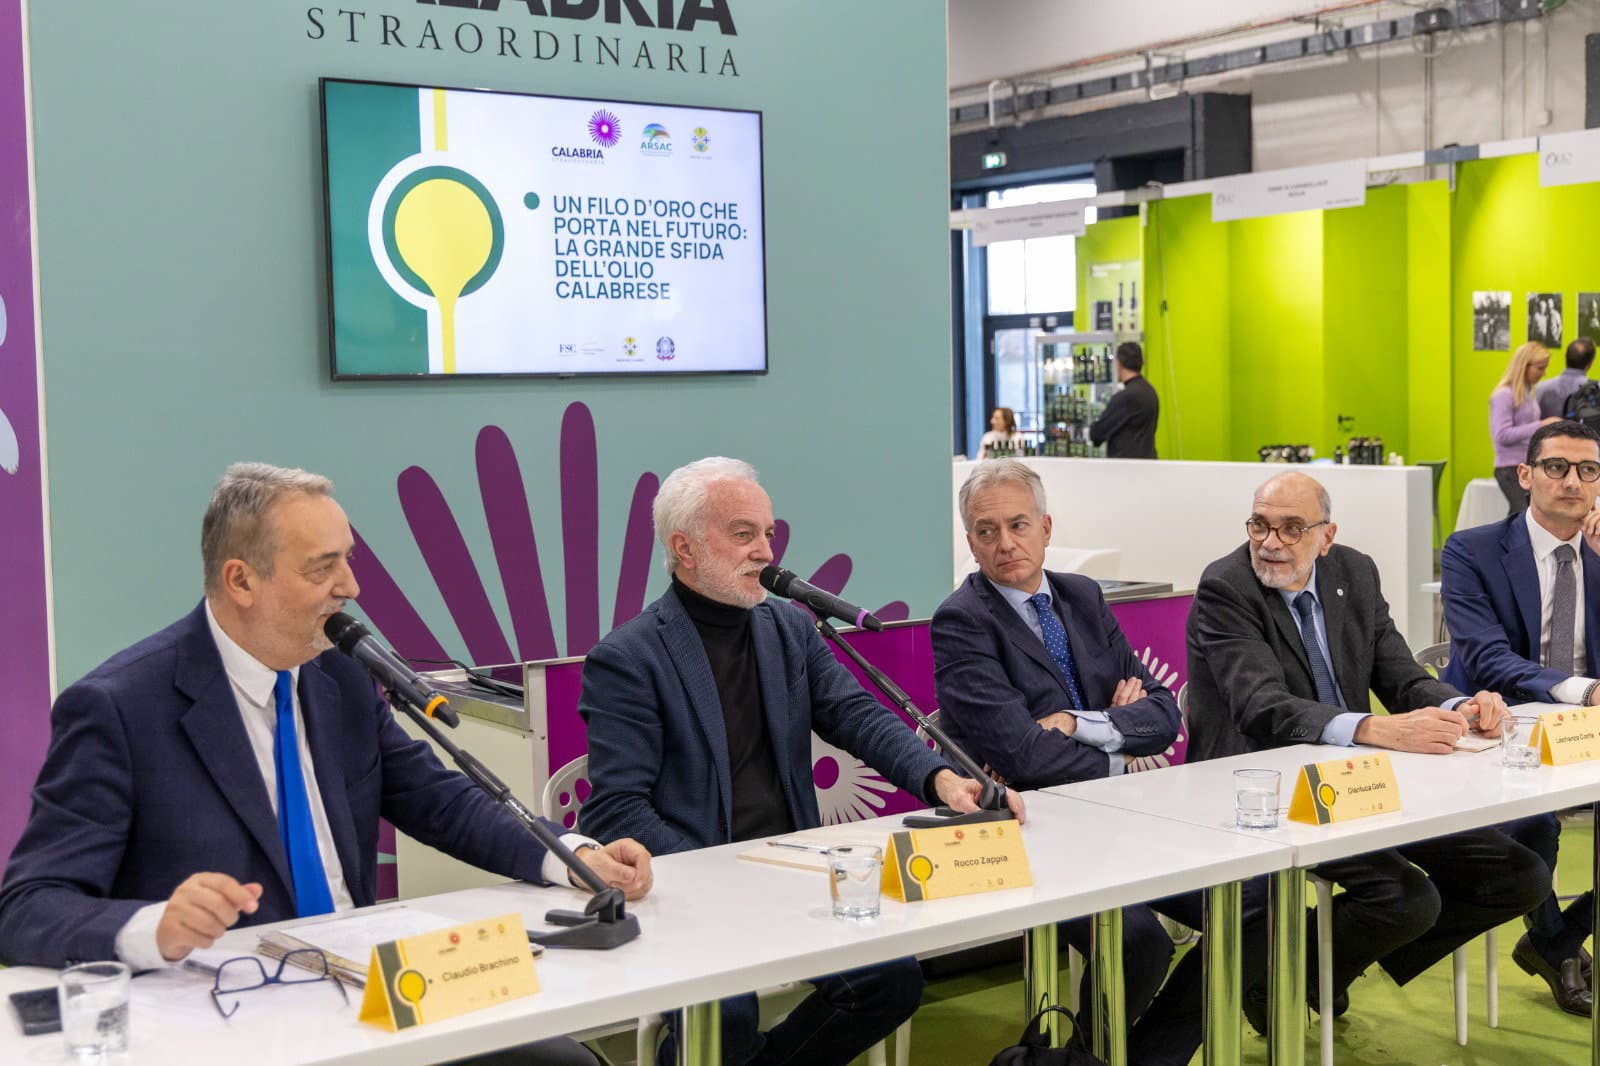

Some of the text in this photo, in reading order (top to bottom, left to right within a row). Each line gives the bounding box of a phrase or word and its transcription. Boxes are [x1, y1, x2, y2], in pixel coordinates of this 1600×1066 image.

[306, 7, 741, 77] STRAORDINARIA
[551, 146, 605, 159] CALABRIA
[639, 141, 673, 152] ARSAC
[553, 195, 582, 214] UN
[587, 196, 629, 216] FILO
[699, 202, 738, 220] CHE
[554, 217, 748, 241] PORTA NEL FUTURO:
[554, 238, 725, 260] LA GRANDE SFIDA
[555, 281, 671, 300] CALABRESE
[954, 855, 1009, 868] Rocco Zappia
[441, 956, 521, 982] Claudio Brachino
